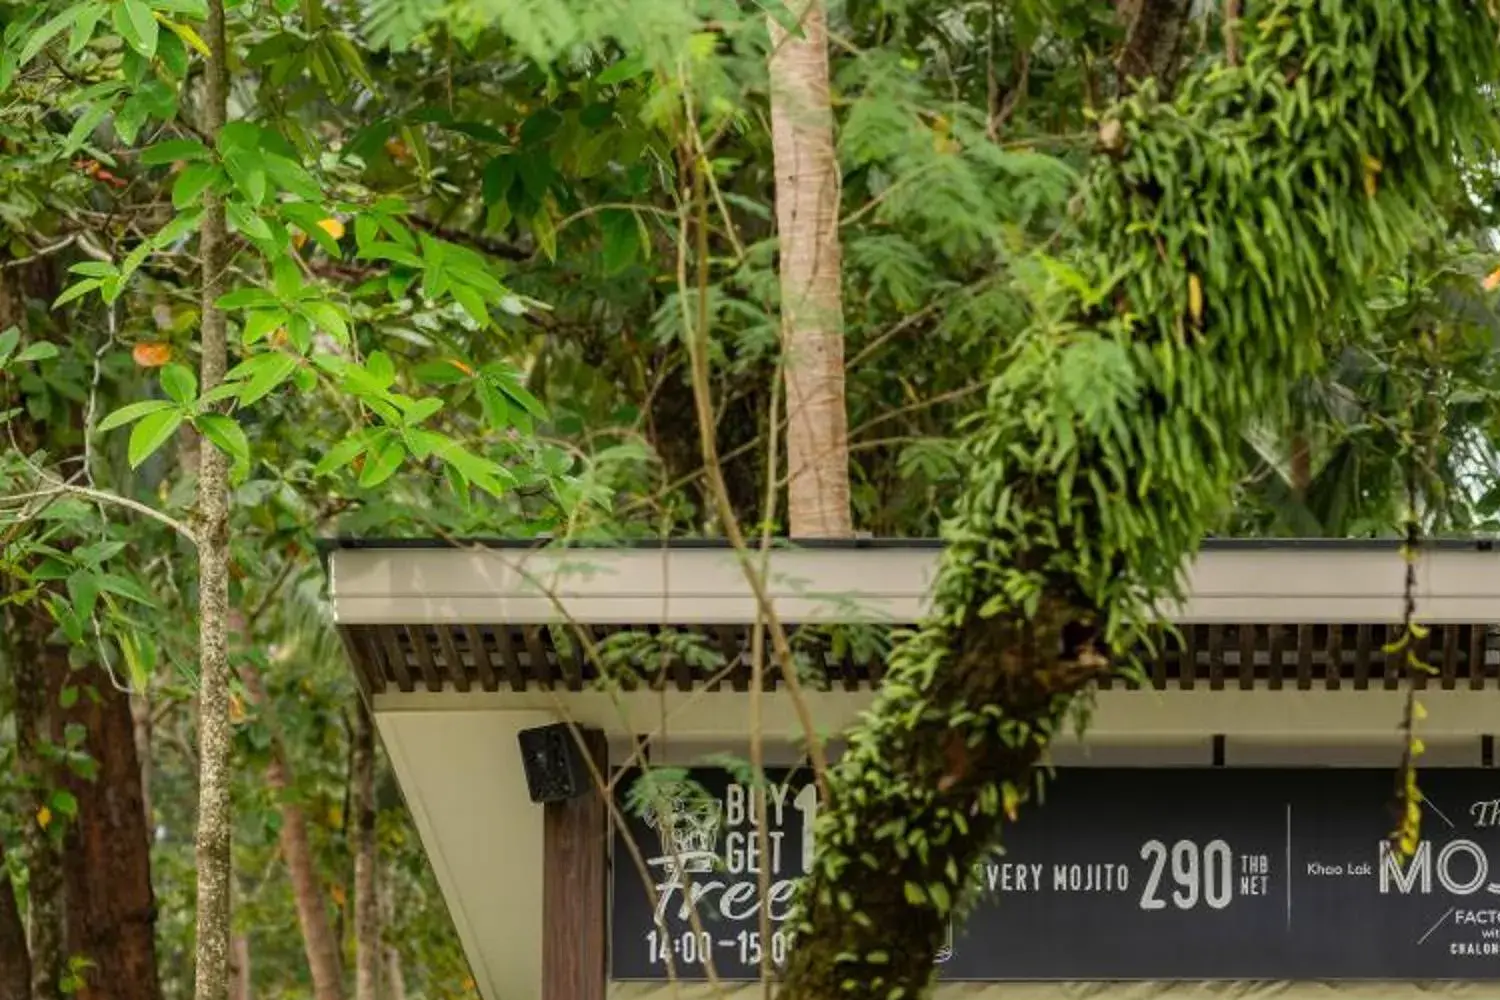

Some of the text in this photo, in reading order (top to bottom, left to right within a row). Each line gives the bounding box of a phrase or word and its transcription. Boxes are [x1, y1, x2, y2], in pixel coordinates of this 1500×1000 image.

[793, 783, 817, 875] 1
[726, 831, 784, 875] GET
[1241, 854, 1269, 873] THB
[1307, 862, 1372, 876] Khao Lak
[1053, 864, 1130, 891] MOJITO
[1140, 839, 1233, 909] 290
[1240, 875, 1269, 895] NET
